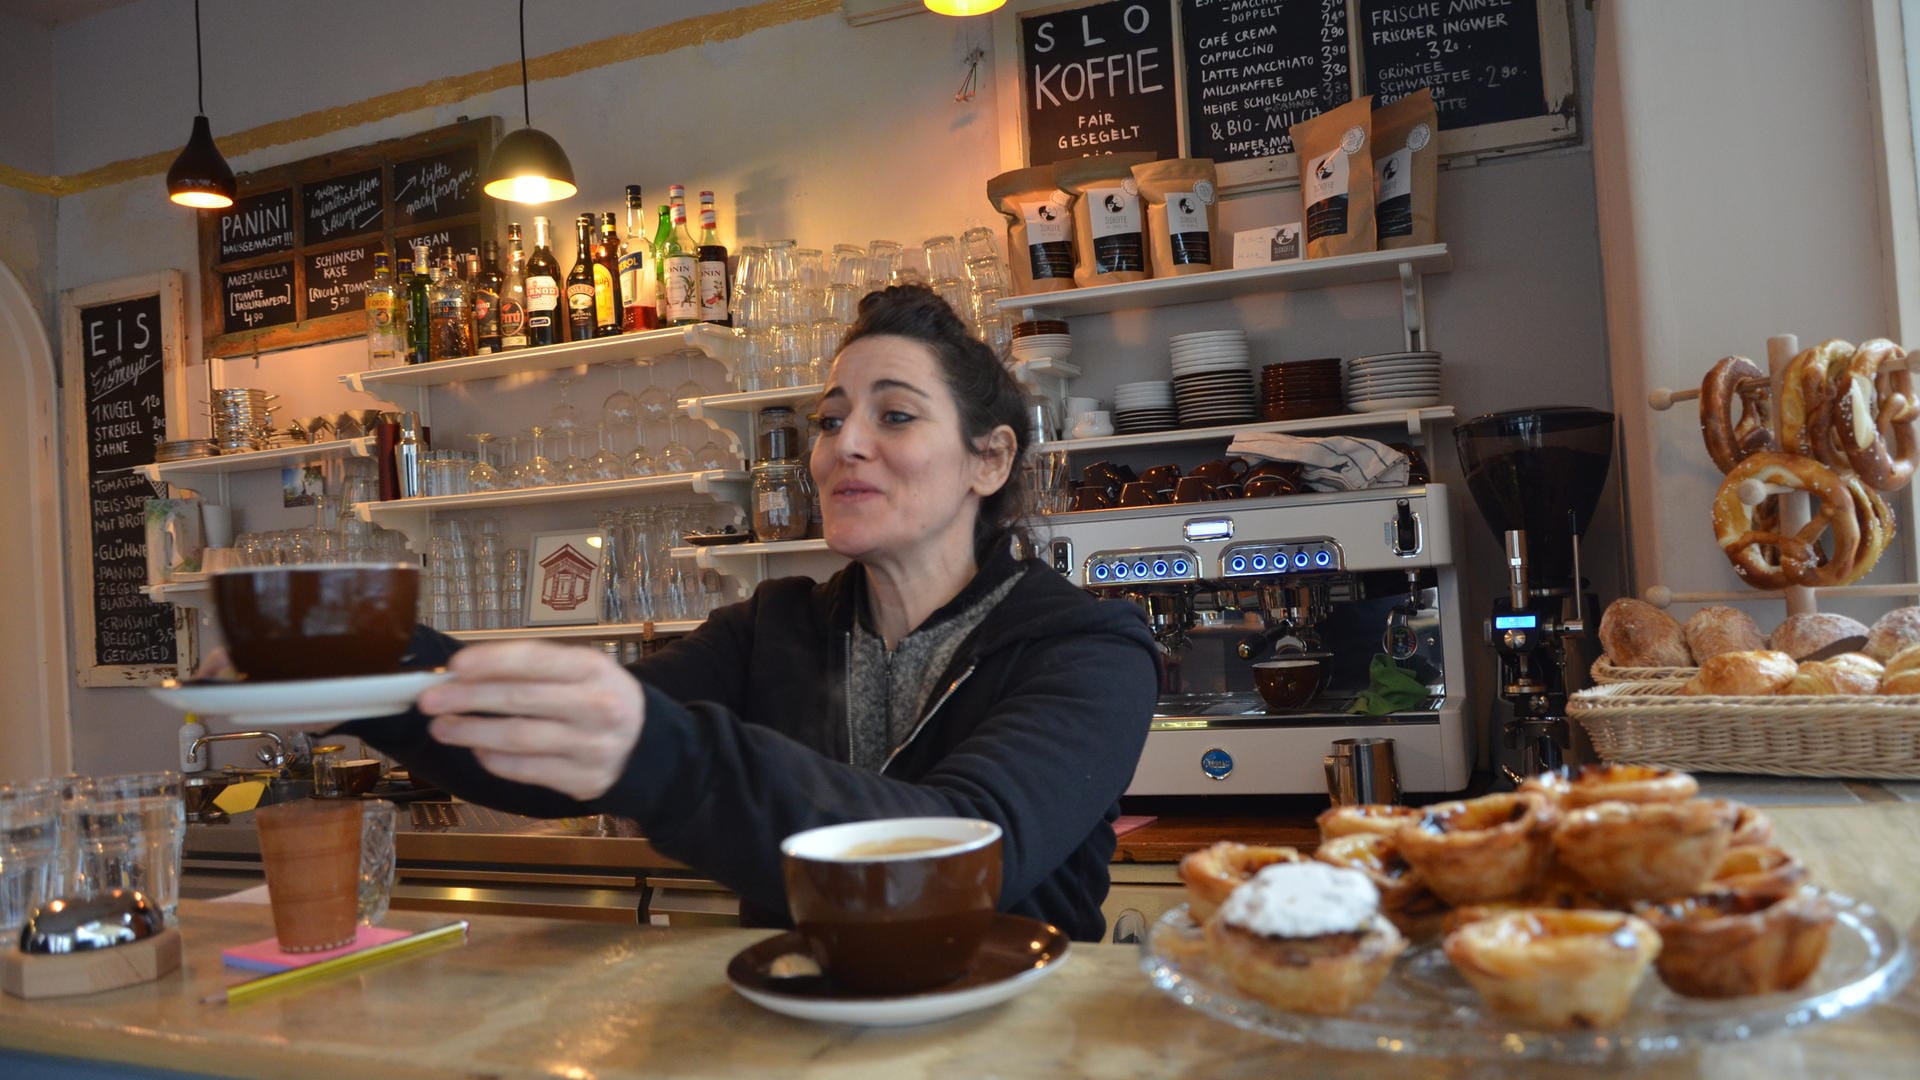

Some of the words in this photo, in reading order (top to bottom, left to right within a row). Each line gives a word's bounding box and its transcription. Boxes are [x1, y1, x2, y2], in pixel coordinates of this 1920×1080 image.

[1371, 2, 1440, 26] FRISCHE
[1199, 32, 1229, 49] CAFÉ
[1235, 25, 1277, 42] CREMA
[1373, 24, 1437, 46] FRISCHER
[1443, 13, 1508, 35] INGWER
[1200, 43, 1274, 65] CAPPUCCINO
[1035, 47, 1165, 110] KOFFIE
[1202, 67, 1239, 83] LATTE
[1243, 56, 1313, 77] MACCHIATO
[1379, 61, 1444, 81] GRÜNTEE
[1203, 76, 1285, 99] MILCHKAFFEE
[1380, 70, 1471, 94] SCHWARZTEE
[1244, 87, 1319, 109] SCHOKOLADE
[1078, 110, 1116, 129] FAIR
[1058, 126, 1140, 149] GESEGELT
[1211, 122, 1224, 141] &
[222, 197, 288, 242] PANINI
[408, 231, 449, 250] VEGAN
[315, 248, 365, 269] SCHINKEN
[227, 266, 288, 289] MOZZARELLA
[91, 307, 150, 356] EIS
[102, 400, 136, 421] KUGEL
[95, 420, 143, 441] STREUSEL
[95, 440, 130, 458] SAHNE
[95, 519, 115, 533] MIT
[103, 644, 170, 663] GETOASTED
